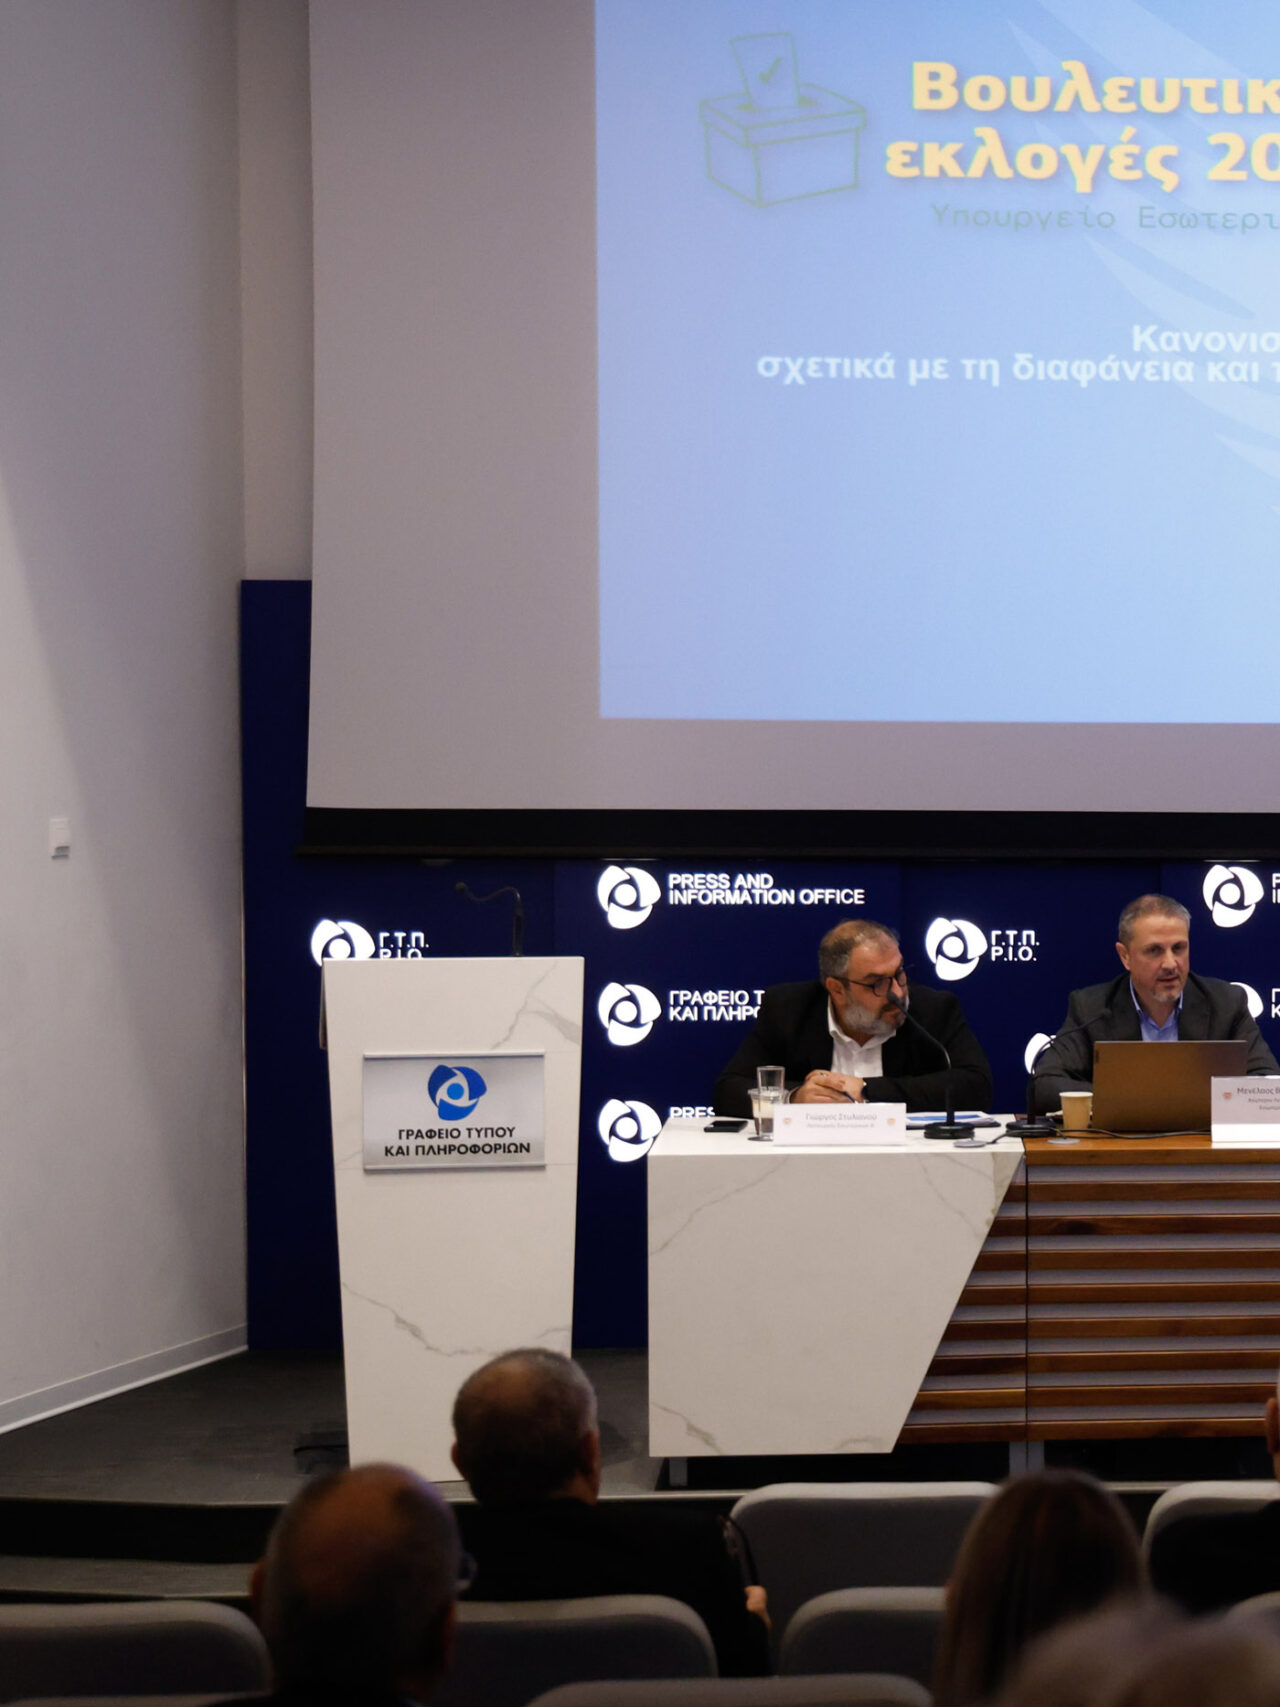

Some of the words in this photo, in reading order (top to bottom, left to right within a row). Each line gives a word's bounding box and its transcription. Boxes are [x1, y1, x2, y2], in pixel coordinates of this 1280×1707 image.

[885, 127, 1179, 193] εκλογές
[931, 203, 1116, 234] Υπουργείο
[757, 354, 895, 386] σχετικά
[909, 360, 949, 387] με
[961, 357, 1000, 387] τη
[1013, 353, 1194, 388] διαφάνεια
[1208, 359, 1259, 383] και
[668, 873, 730, 889] PRESS
[734, 873, 774, 889] AND
[668, 889, 795, 905] INFORMATION
[799, 889, 865, 904] OFFICE
[379, 931, 430, 948] Γ.Τ.Π.
[990, 930, 1040, 946] Γ.Τ.Π.
[990, 946, 1037, 961] P.I.O.
[669, 989, 750, 1005] ΓΡΑΦΕΙΟ
[669, 1005, 698, 1021] ΚΑΙ
[398, 1127, 461, 1140] ΓΡΑΦΕΙΟ
[466, 1126, 516, 1139] ΤΥΠΟΥ
[384, 1145, 410, 1157] ΚΑΙ
[415, 1142, 531, 1157] ΠΛΗΡΟΦΟΡΙΩΝ
